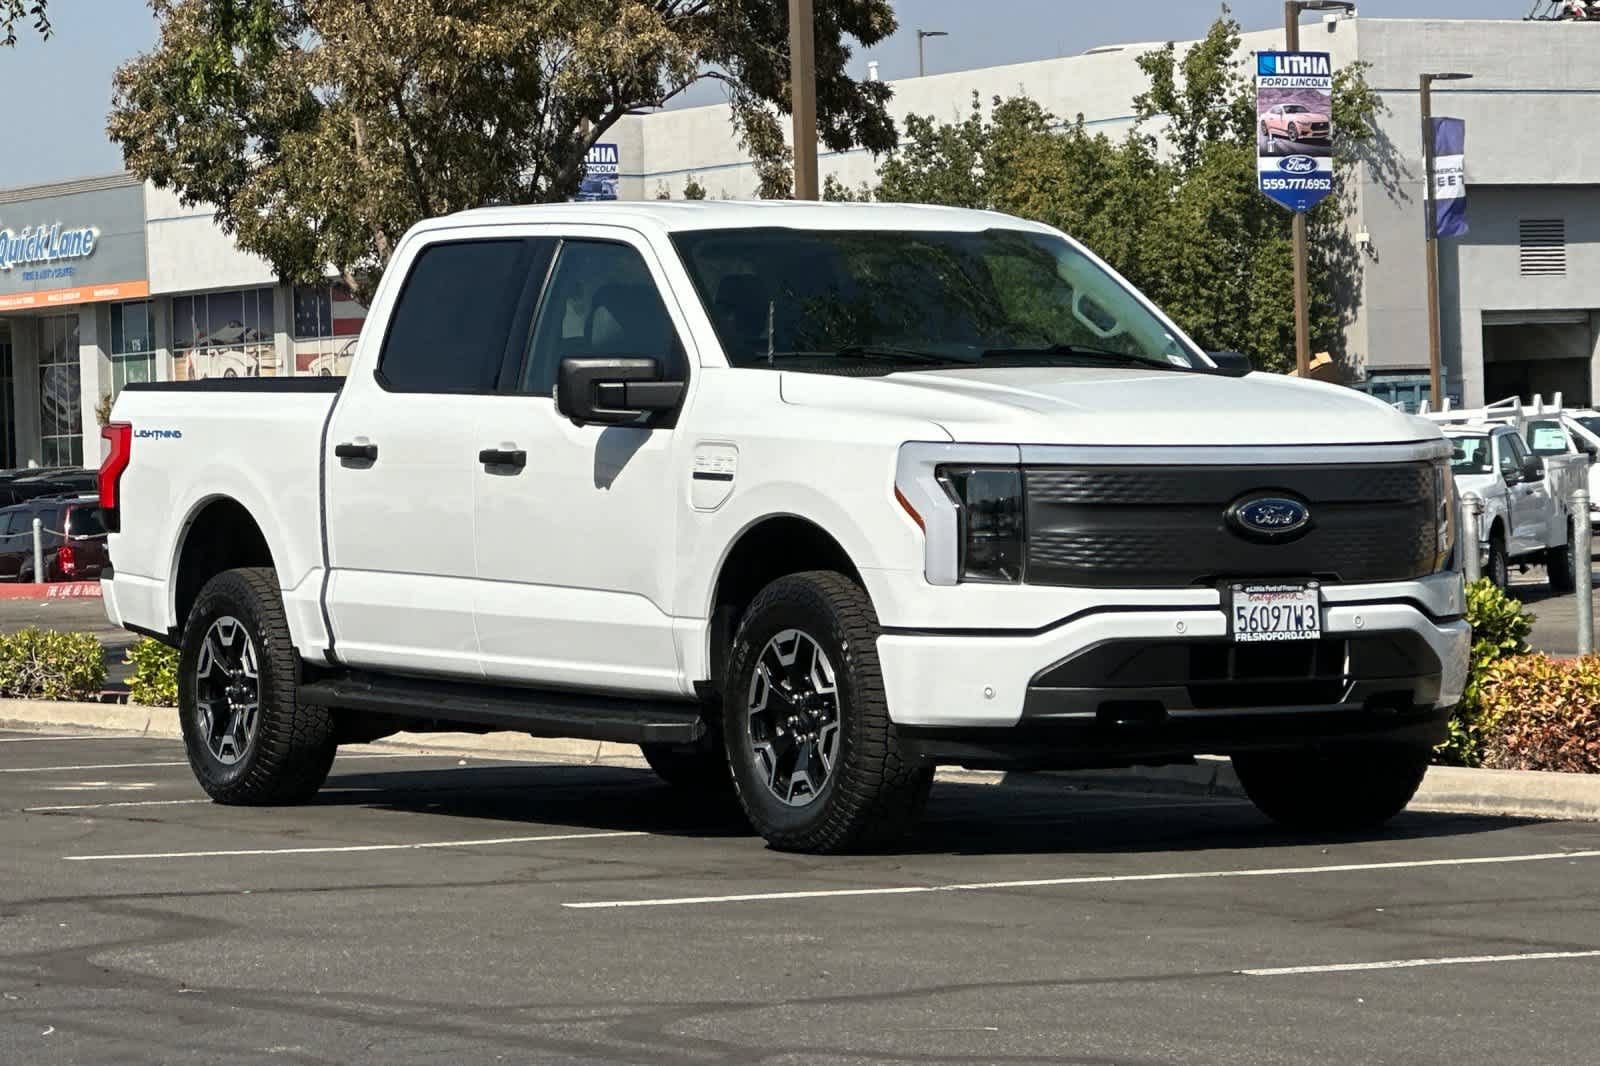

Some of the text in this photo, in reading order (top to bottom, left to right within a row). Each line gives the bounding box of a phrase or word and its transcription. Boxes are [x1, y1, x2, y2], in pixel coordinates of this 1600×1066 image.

[1275, 56, 1329, 74] LITHIA
[1261, 78, 1329, 87] FORD LINCOLN
[584, 147, 617, 163] HIA
[587, 165, 617, 173] NCOLN
[1286, 157, 1313, 171] Ford
[1263, 178, 1331, 190] 559.777.6952
[1437, 175, 1464, 188] EET
[0, 223, 96, 269] Quick Lane
[134, 430, 182, 440] LIGHTNING
[1256, 505, 1294, 524] Ford
[1236, 604, 1316, 632] 56097W3
[1235, 630, 1320, 642] FRESNOFORD.COM
